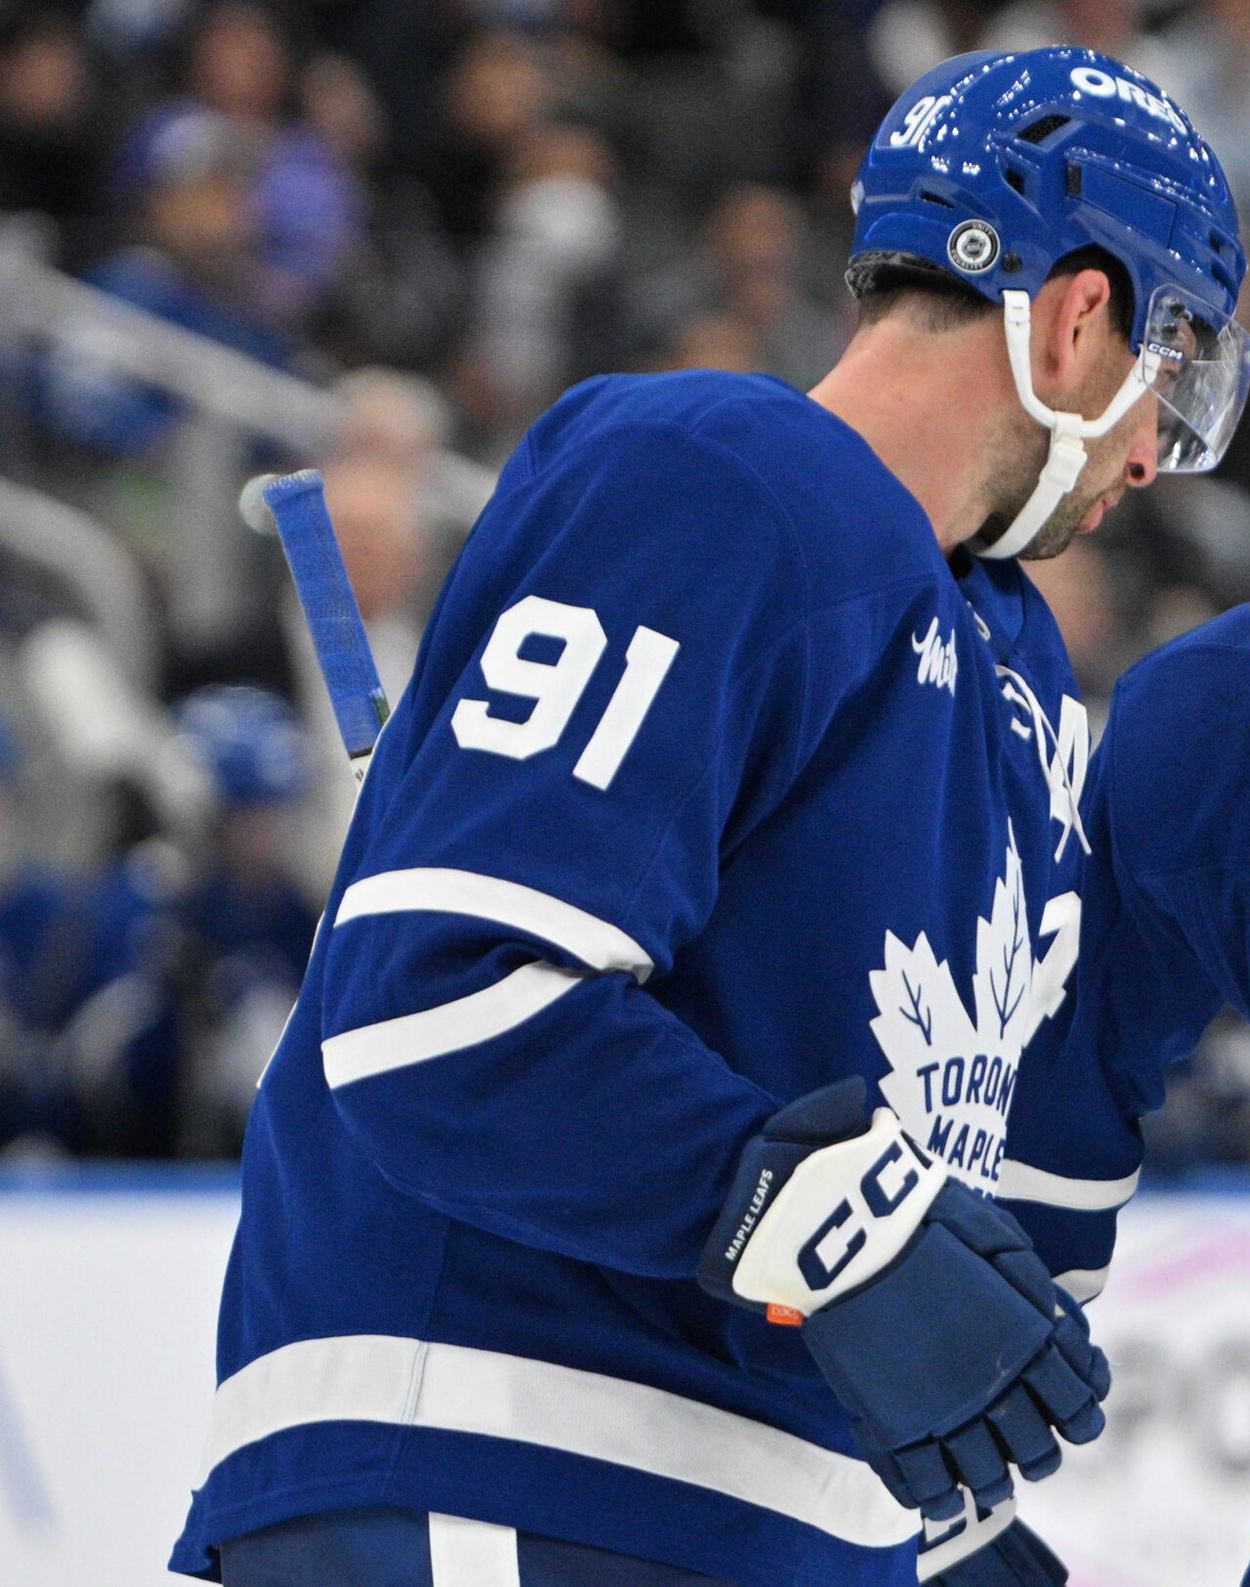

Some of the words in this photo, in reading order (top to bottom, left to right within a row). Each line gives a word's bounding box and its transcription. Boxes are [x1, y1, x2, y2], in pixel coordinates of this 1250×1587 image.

[890, 95, 952, 148] 91
[1070, 67, 1187, 136] OREO
[1147, 342, 1184, 360] CCM
[451, 595, 680, 790] 91
[1050, 693, 1089, 826] A
[927, 1114, 1007, 1181] MAPLE
[725, 1214, 756, 1261] MAPLE
[750, 1169, 773, 1213] LEAFS
[797, 1129, 934, 1291] CC
